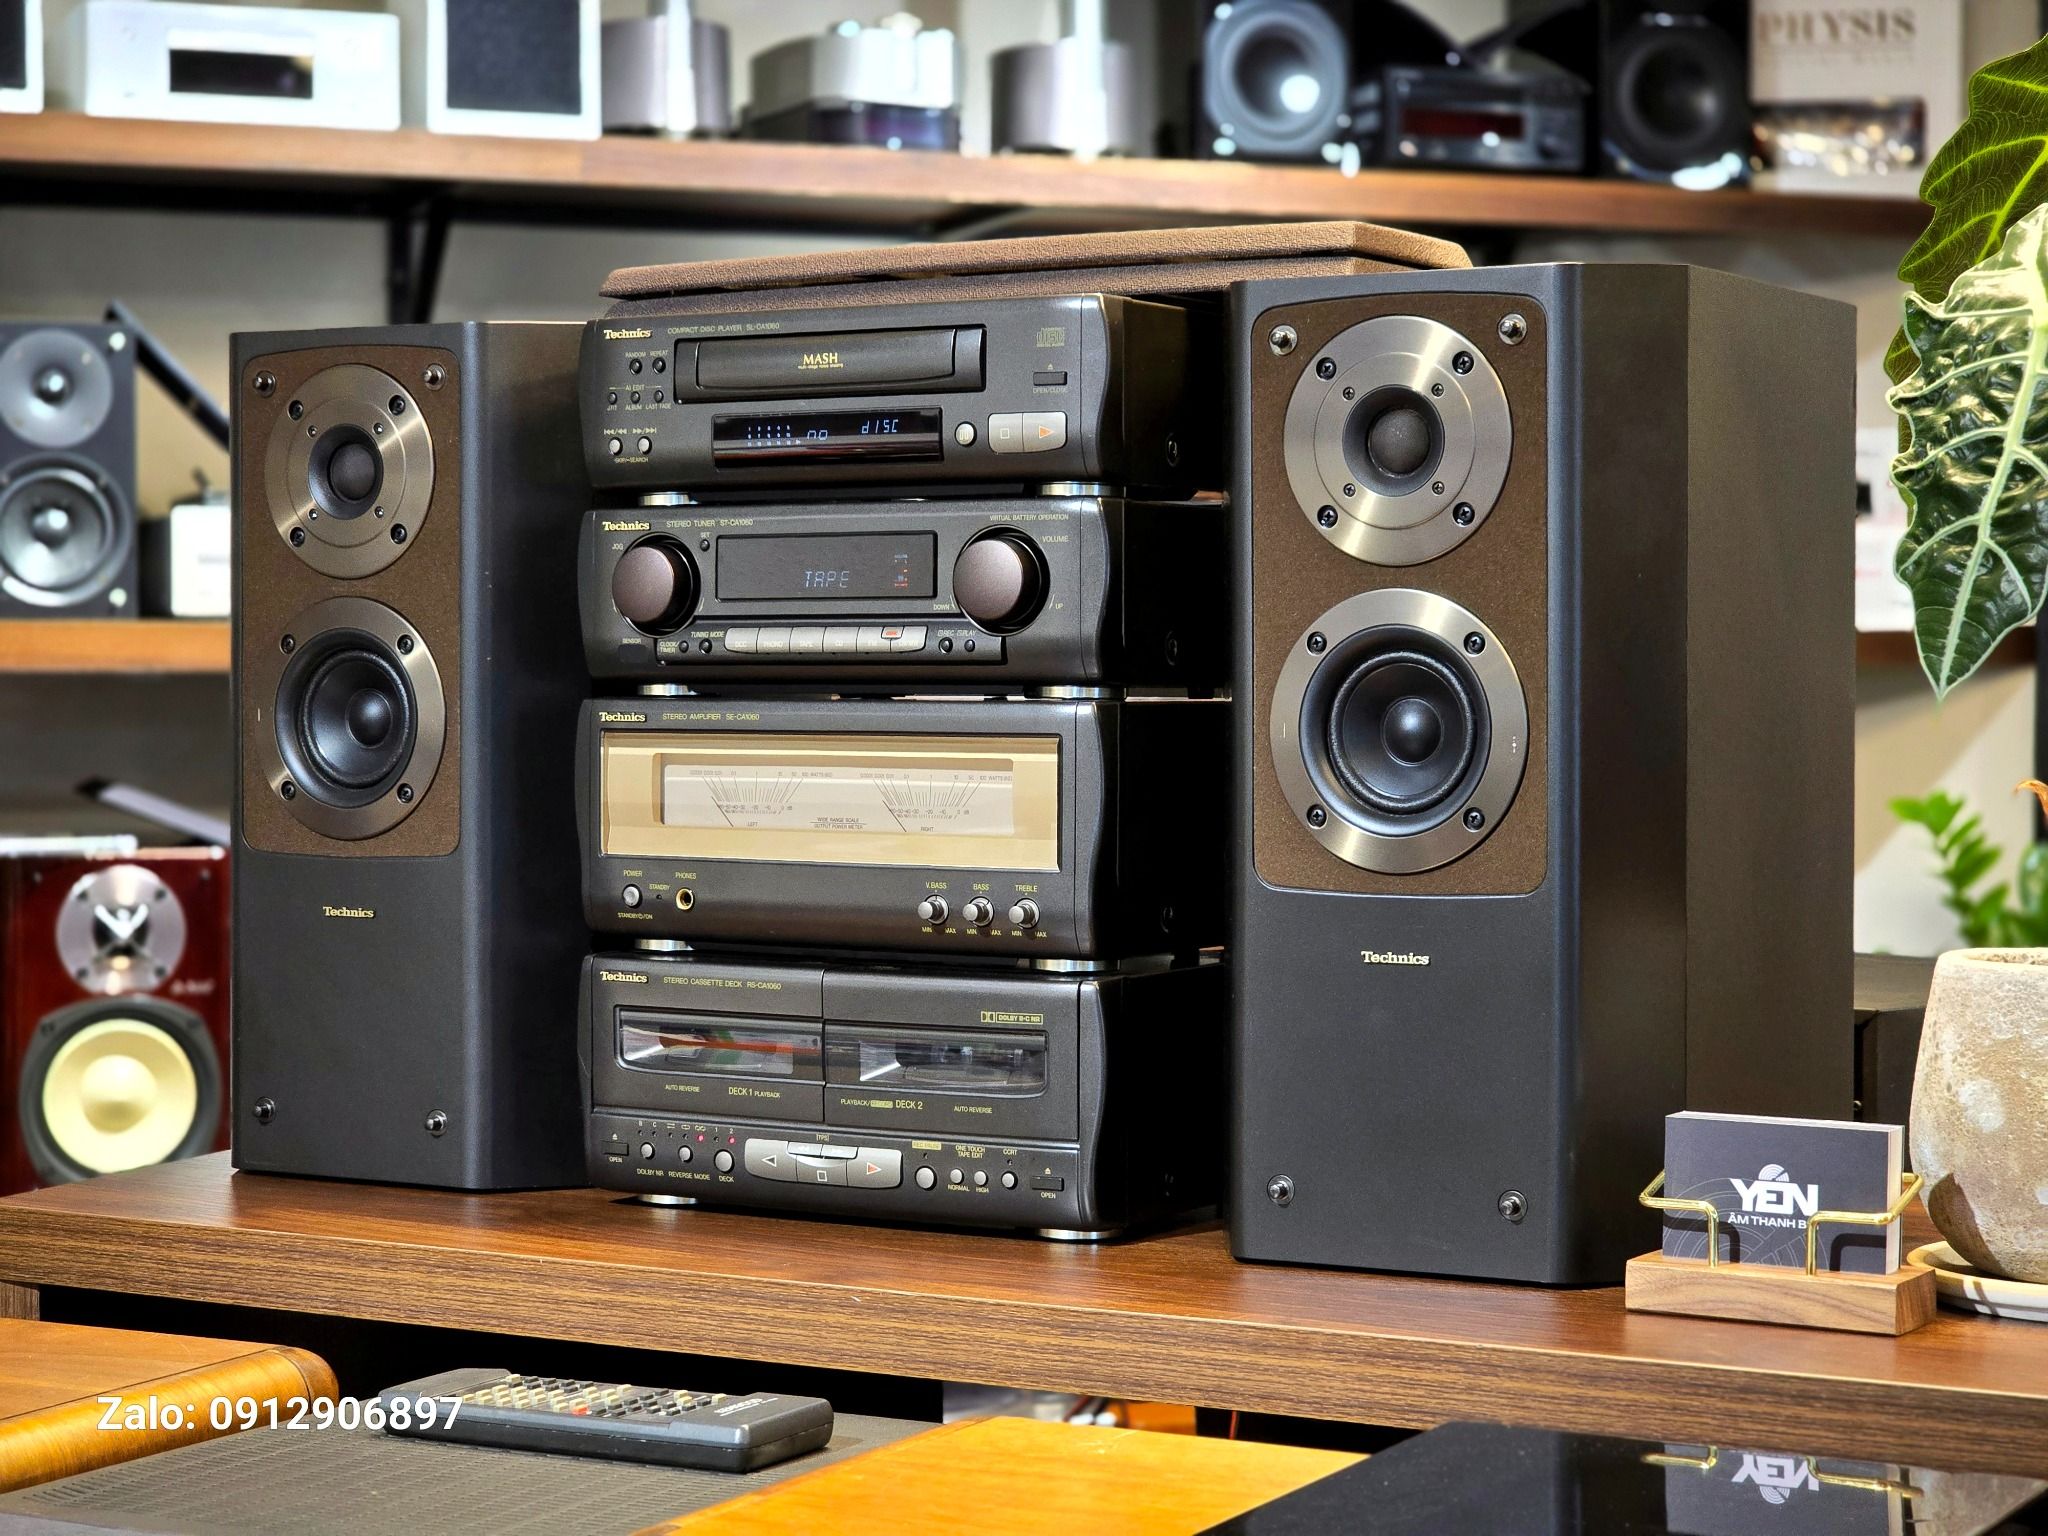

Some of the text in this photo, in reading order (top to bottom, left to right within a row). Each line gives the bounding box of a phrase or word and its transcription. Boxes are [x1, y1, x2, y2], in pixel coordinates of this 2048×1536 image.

[667, 326, 700, 335] COMPACT
[699, 325, 716, 334] DISC
[717, 324, 743, 333] PLAYER
[603, 328, 652, 340] Technics
[803, 352, 838, 365] MASH
[1037, 513, 1069, 521] OPERATION
[602, 521, 650, 531] Technics
[666, 520, 691, 528] STEREO
[694, 519, 716, 528] TUNER
[1041, 535, 1069, 543] VOLUME
[805, 571, 849, 588] TAPE
[933, 603, 950, 611] DOWN
[1055, 602, 1064, 610] UP
[599, 711, 646, 722] Technics
[662, 713, 760, 721] STEREO AMPLIFIER SE-CA1060
[624, 869, 643, 877] POWER
[675, 871, 697, 879] PHONES
[649, 883, 670, 891] STANDBY
[925, 882, 947, 890] V.BASS
[973, 883, 989, 891] BASS
[1015, 884, 1038, 892] TREBLE
[322, 906, 375, 918] Technics
[1361, 951, 1430, 965] Technics
[600, 971, 648, 983] Technics
[663, 976, 782, 990] STEREO CASSETTE DECK RS-CA1060
[998, 1014, 1018, 1022] DOLBY
[679, 1085, 700, 1093] REVERSE
[728, 1086, 781, 1098] DECK 1 PLAYBACK
[895, 1099, 916, 1109] DECK
[917, 1101, 923, 1110] 2
[953, 1105, 993, 1114] AUTO REVERSE
[955, 1144, 986, 1153] ONE TOUCH
[608, 1155, 623, 1163] OPEN
[636, 1168, 654, 1176] DOLBY
[668, 1171, 711, 1181] REVERSE MODE
[718, 1175, 735, 1183] DECK
[947, 1184, 970, 1192] NORMAL
[1728, 1212, 1750, 1225] ÂM
[1751, 1215, 1796, 1229] THANH
